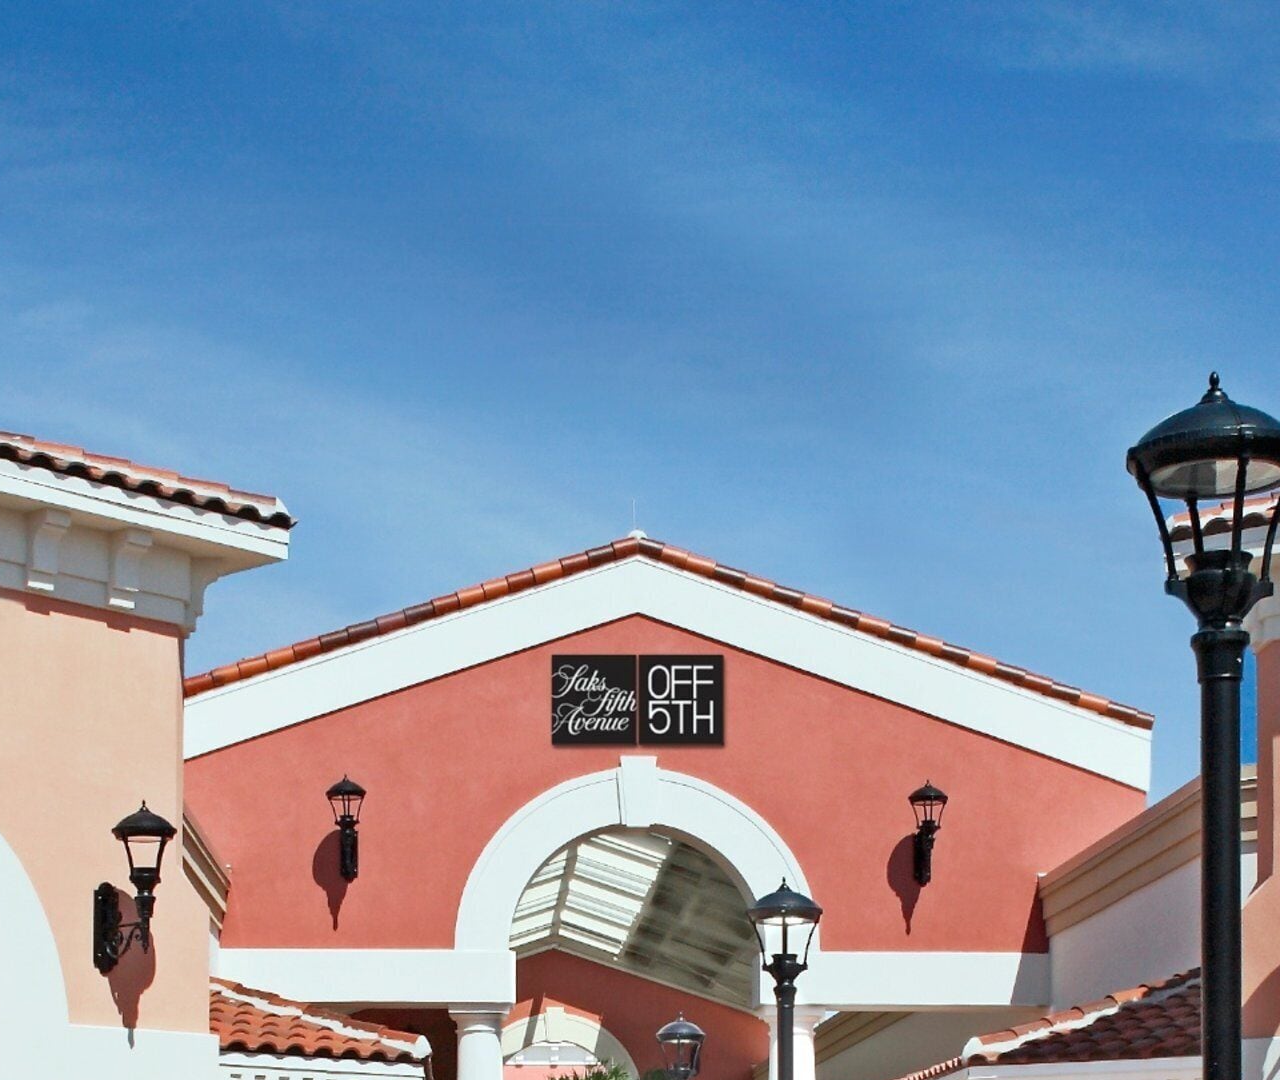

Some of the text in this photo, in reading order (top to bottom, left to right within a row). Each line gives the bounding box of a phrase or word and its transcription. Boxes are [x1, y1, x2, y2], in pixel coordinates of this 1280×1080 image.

[552, 664, 607, 698] Saks
[647, 664, 714, 699] OFF
[552, 702, 630, 735] Avenue
[647, 699, 714, 735] 5TH
